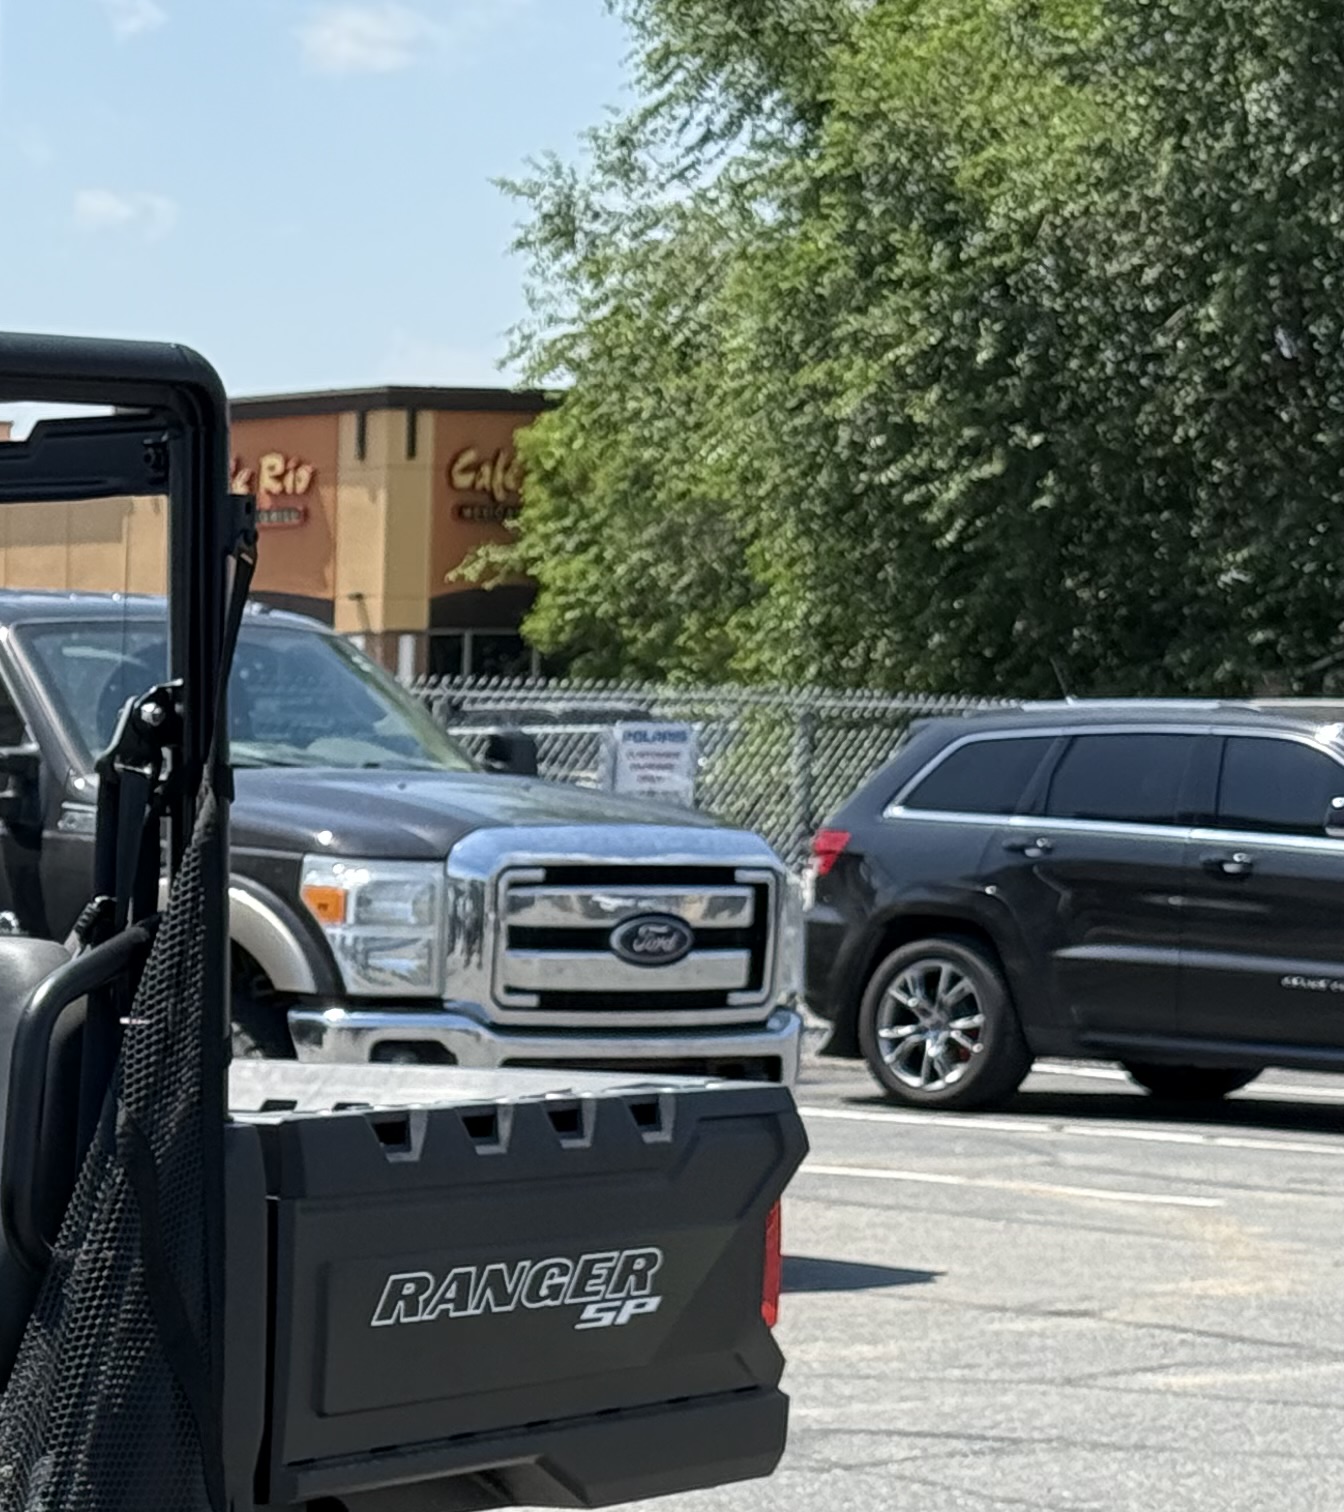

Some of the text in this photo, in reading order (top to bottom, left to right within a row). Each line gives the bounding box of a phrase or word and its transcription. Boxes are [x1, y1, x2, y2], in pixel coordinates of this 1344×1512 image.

[259, 452, 313, 497] Rio
[633, 924, 678, 952] Ford
[371, 1246, 663, 1327] RANGER
[574, 1295, 662, 1330] SP
